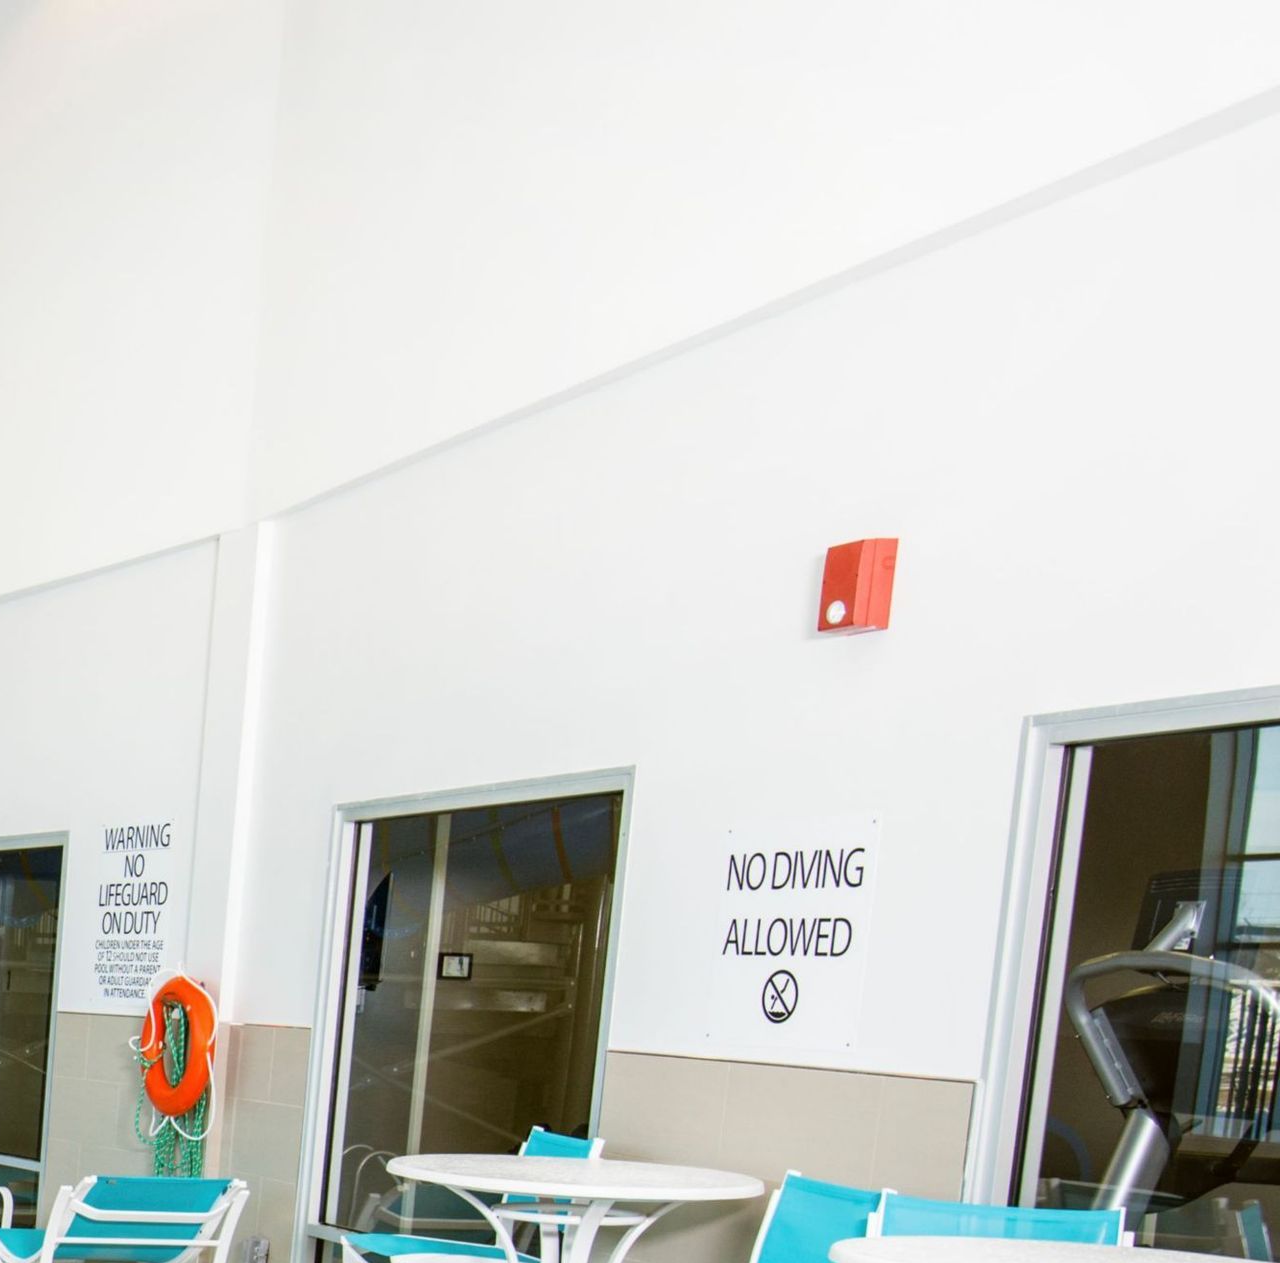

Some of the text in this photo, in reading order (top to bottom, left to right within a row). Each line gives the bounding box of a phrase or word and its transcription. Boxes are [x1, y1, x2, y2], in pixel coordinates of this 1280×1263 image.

[105, 823, 171, 850] WARNING
[124, 853, 145, 878] NO
[726, 847, 865, 891] NO DIVING
[98, 881, 169, 907] LIFEGUARD
[102, 911, 161, 935] ON DUTY
[95, 939, 164, 950] CHILDREN UNDER THE AGE
[722, 917, 852, 957] ALLOWED
[97, 951, 105, 961] OF
[113, 951, 134, 962] SHOULD
[135, 952, 147, 962] NOT
[147, 952, 159, 962] USE
[94, 963, 108, 974] POOL
[109, 963, 133, 974] WITHOUT
[139, 964, 161, 975] PARENT
[107, 975, 124, 986] ADULT
[103, 988, 110, 998] IN
